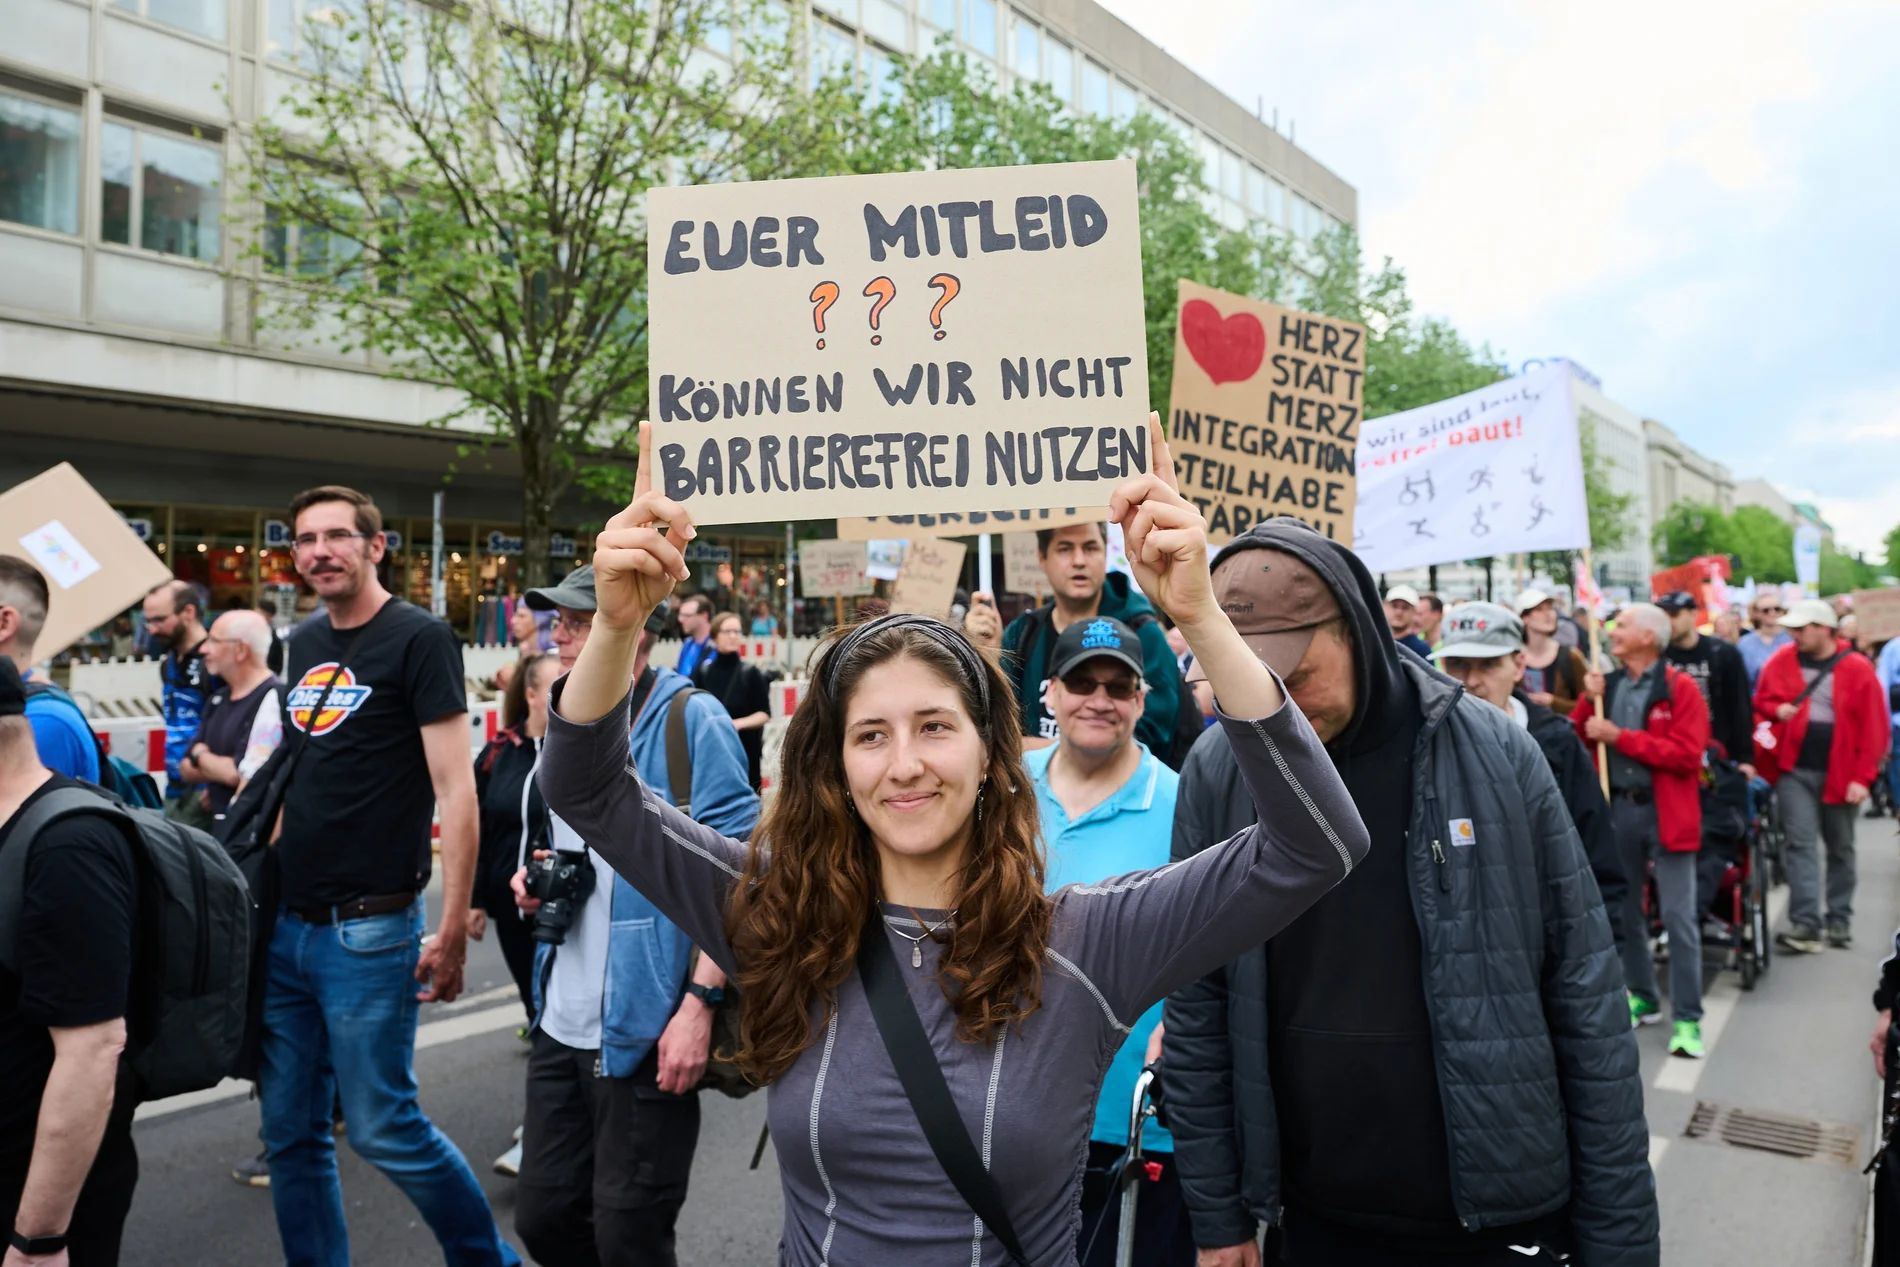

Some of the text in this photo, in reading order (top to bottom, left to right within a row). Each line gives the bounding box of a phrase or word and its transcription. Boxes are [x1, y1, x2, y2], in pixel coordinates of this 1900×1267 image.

[664, 194, 1109, 275] EUER MITLEID
[808, 272, 961, 351] ? ? ?
[1279, 314, 1362, 364] HERZ
[658, 356, 1132, 423] KÖNNEN WIR NICHT
[1271, 353, 1363, 401] STATT
[1173, 408, 1356, 477] INTEGRATION
[1267, 390, 1359, 443] MERZ
[1418, 406, 1473, 438] sind
[658, 425, 1147, 502] BARRIEREFREI NUTZEN
[289, 689, 358, 706] Dicies
